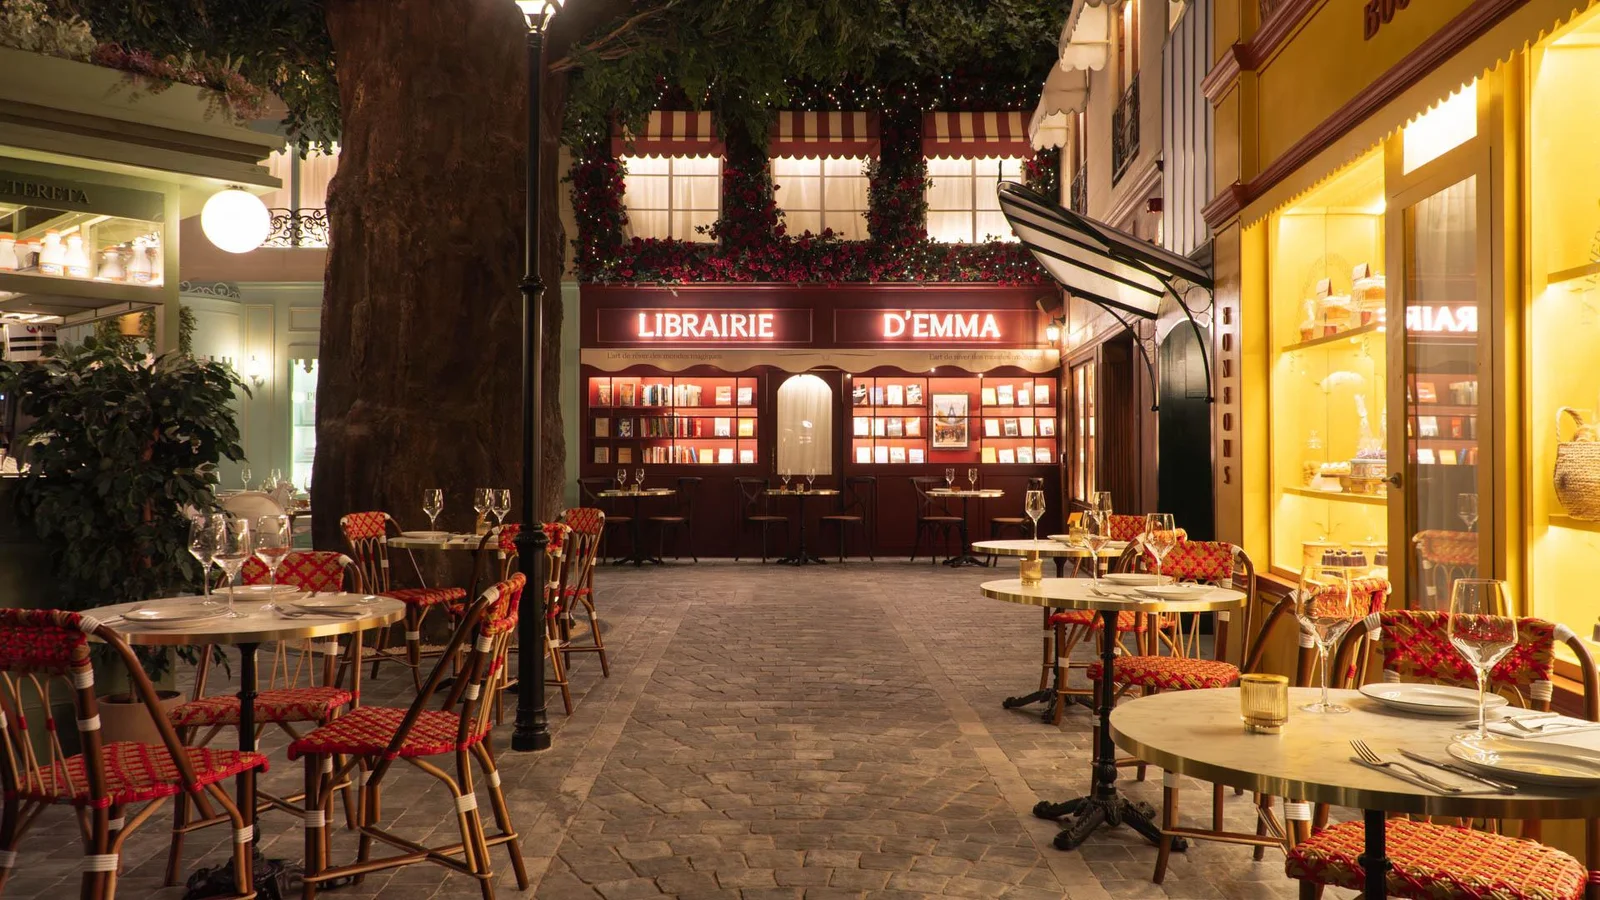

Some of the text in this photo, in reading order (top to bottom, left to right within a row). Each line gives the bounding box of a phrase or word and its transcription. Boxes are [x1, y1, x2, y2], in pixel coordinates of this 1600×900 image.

[637, 312, 775, 338] LIBRAIRIE
[883, 310, 1001, 339] D'EMMA
[1222, 306, 1232, 485] BONBONS
